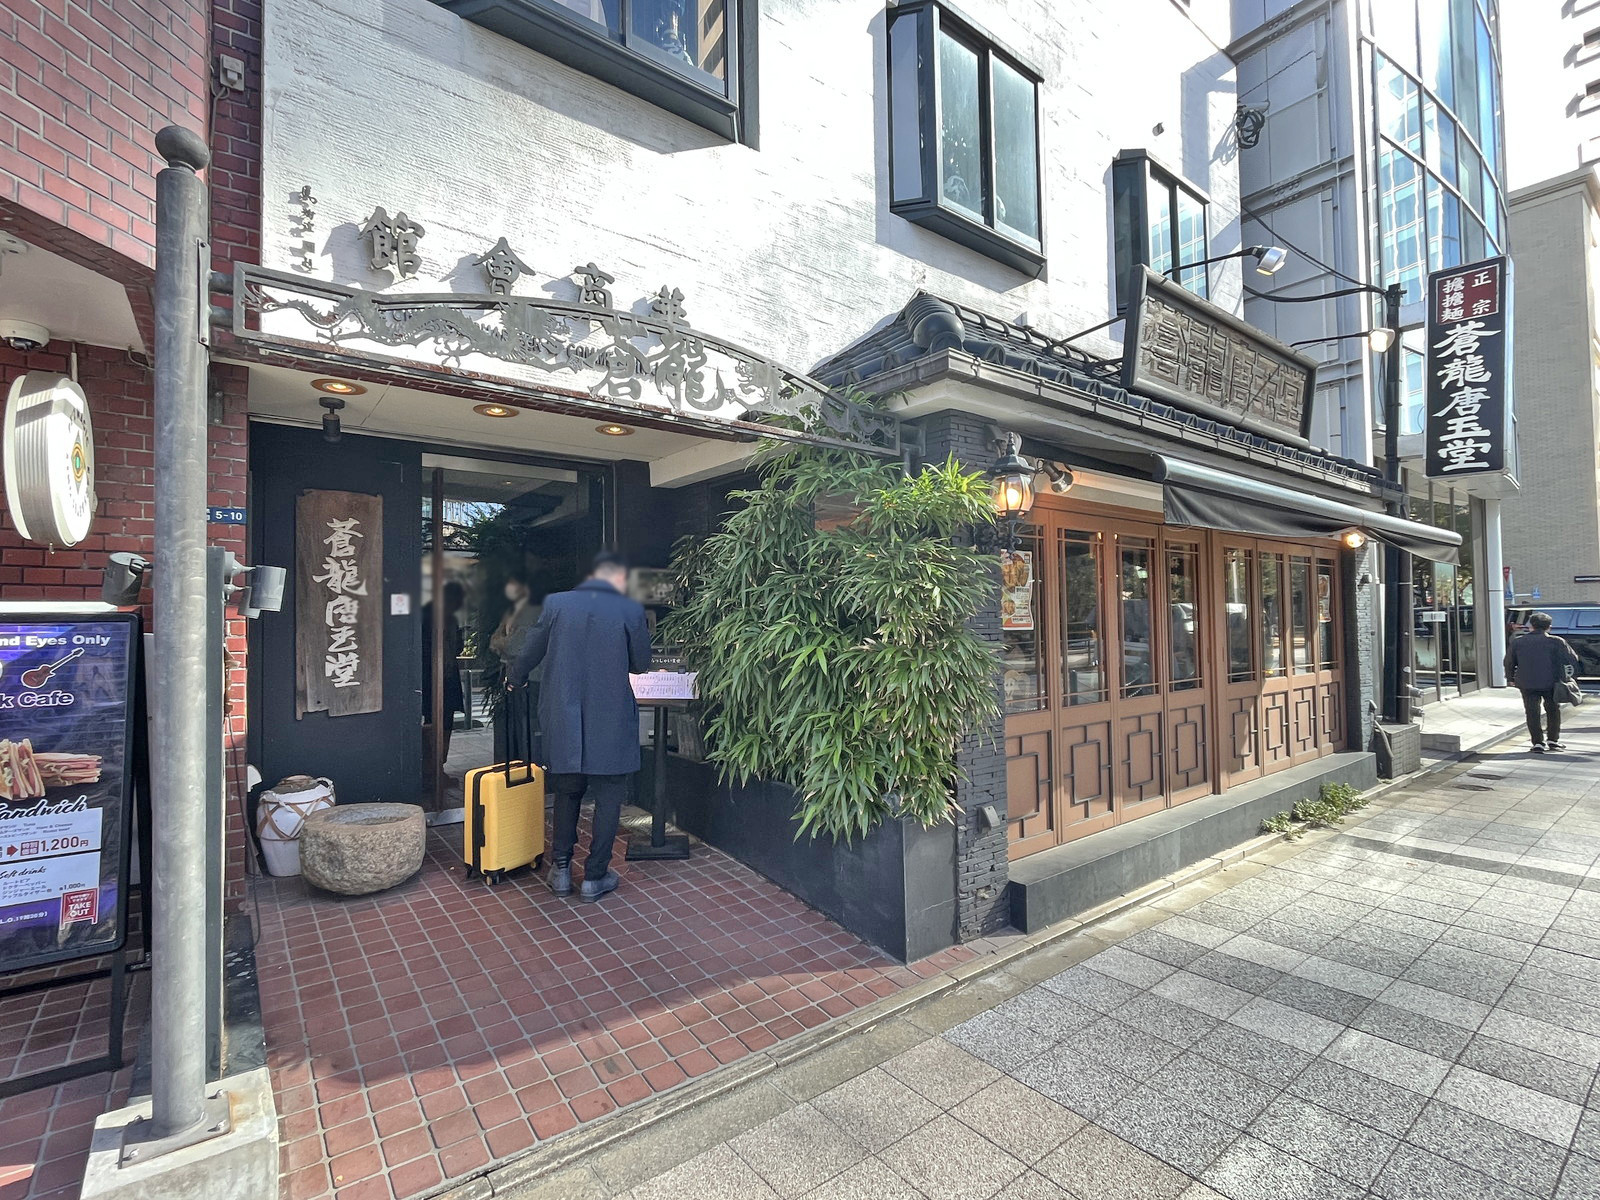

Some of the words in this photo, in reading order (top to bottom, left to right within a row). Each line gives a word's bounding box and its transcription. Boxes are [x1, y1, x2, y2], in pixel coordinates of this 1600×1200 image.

[1432, 320, 1502, 472] 蒼龍唐玉堂
[215, 510, 243, 521] 5-10
[25, 635, 67, 648] Eyes
[72, 634, 111, 646] Only
[18, 690, 75, 708] Cafe
[41, 836, 89, 852] 1,200円
[69, 901, 91, 910] TAKE
[70, 908, 90, 917] OUT
